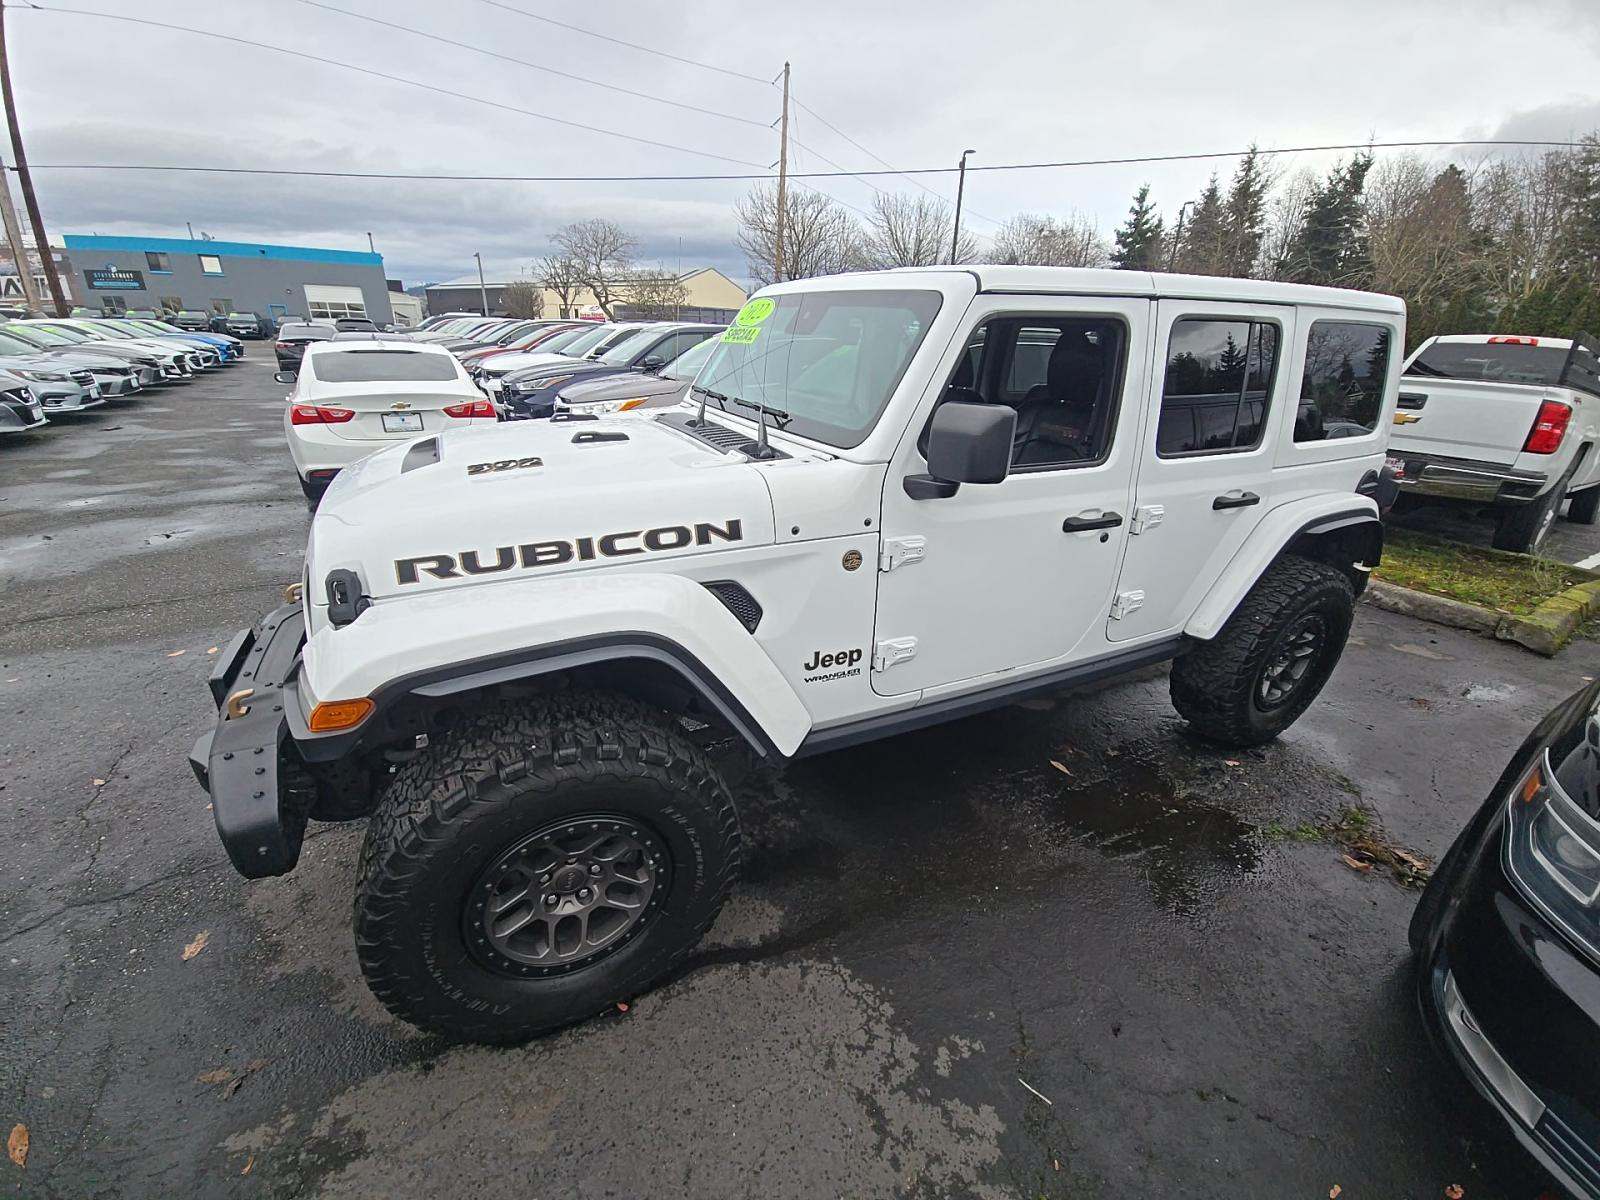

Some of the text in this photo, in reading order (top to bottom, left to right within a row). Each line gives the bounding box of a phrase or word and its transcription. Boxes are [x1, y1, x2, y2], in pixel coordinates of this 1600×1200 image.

[467, 457, 543, 475] 392
[393, 519, 743, 585] RUBICON
[804, 649, 862, 671] Jeep
[804, 668, 861, 682] WRANGLER
